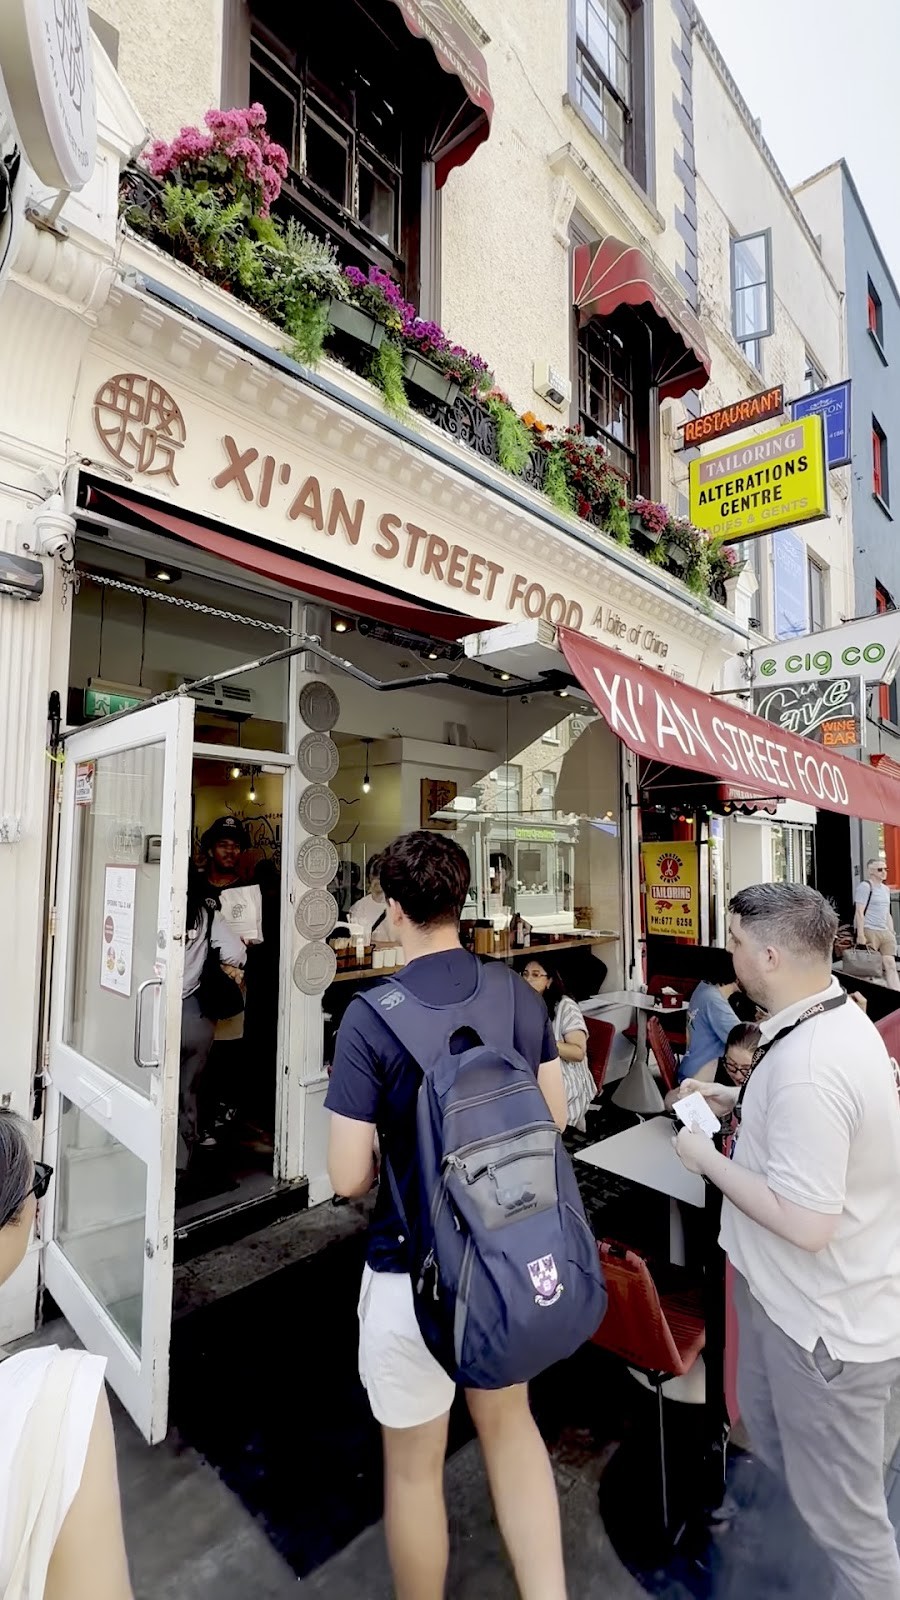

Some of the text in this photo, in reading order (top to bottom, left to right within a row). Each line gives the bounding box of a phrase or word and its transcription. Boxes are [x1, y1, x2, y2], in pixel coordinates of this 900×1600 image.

[685, 388, 781, 442] RESTAURANT
[705, 433, 797, 478] TAILORING
[698, 455, 809, 506] ALTERATIONS
[720, 484, 783, 517] CENTRE
[761, 497, 809, 520] GENTS
[214, 434, 584, 631] XI'AN STREET FOOD
[592, 606, 669, 658] A bite of China
[760, 642, 886, 677] e cig co
[800, 682, 818, 696] LA
[821, 719, 856, 732] WINE
[823, 732, 857, 745] BAR
[711, 716, 797, 790] STREET
[793, 750, 850, 805] FOOD
[652, 886, 691, 900] TAILORING
